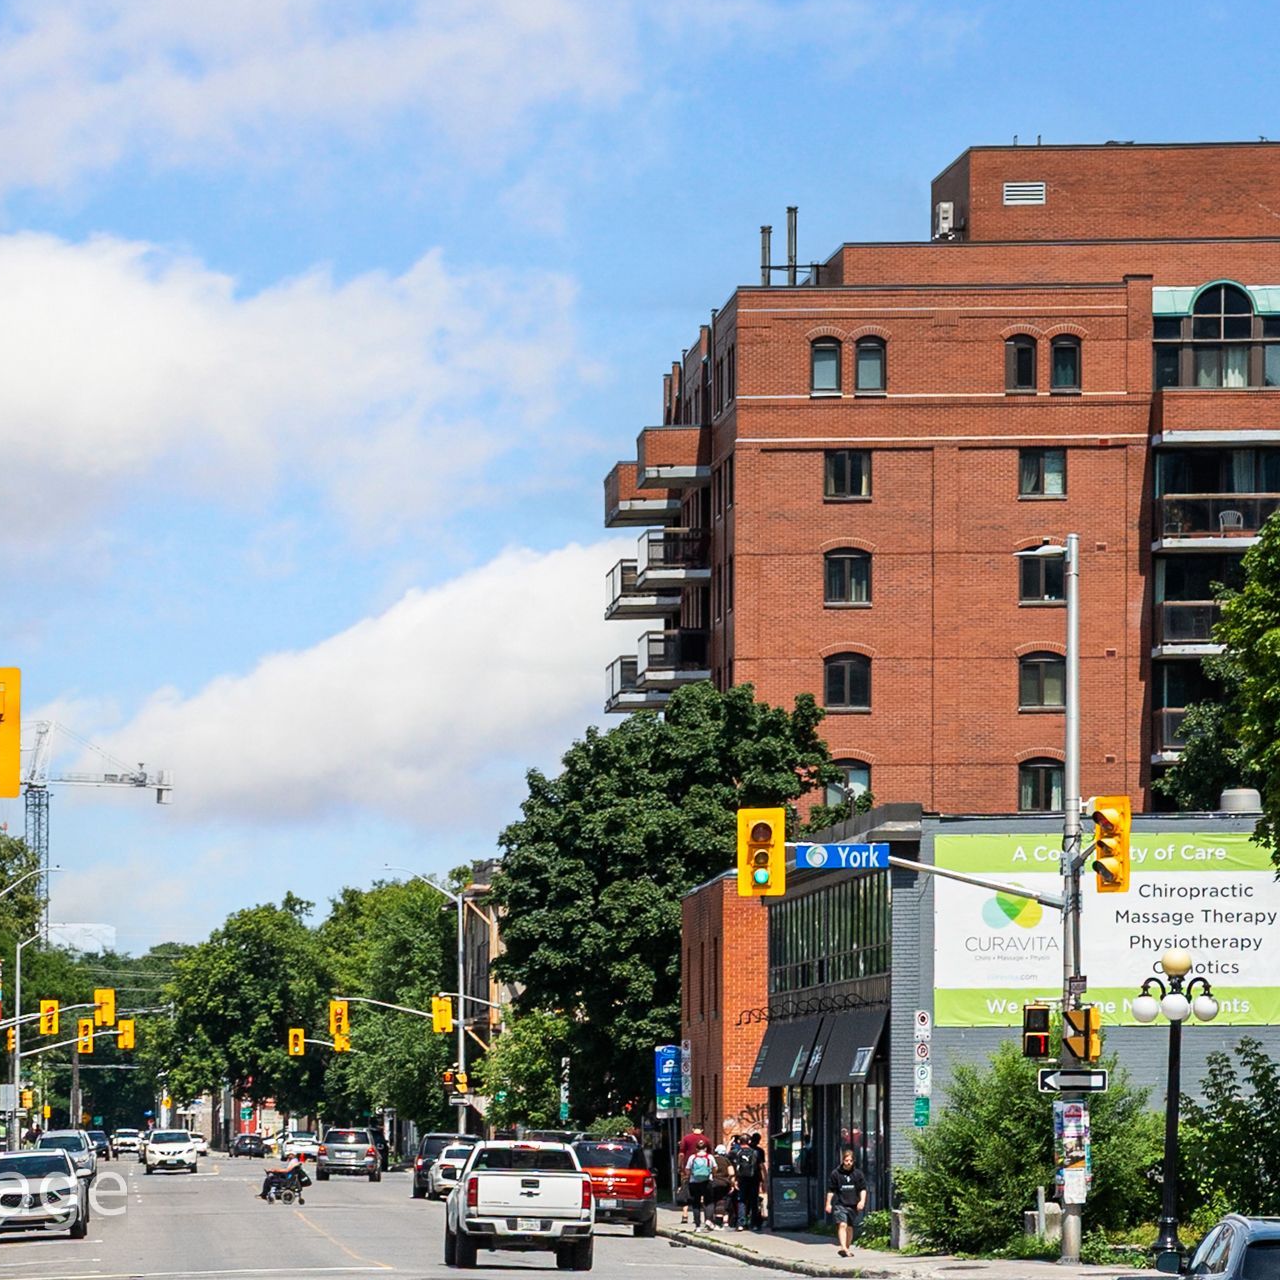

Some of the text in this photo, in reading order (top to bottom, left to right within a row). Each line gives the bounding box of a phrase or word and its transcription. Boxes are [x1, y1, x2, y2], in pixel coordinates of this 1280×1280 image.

[837, 845, 879, 867] York
[1012, 846, 1028, 861] A
[1154, 844, 1175, 860] of
[1181, 845, 1227, 860] Care
[1139, 883, 1254, 900] Chiropractic
[1115, 909, 1278, 926] Massage Therapy
[965, 936, 1060, 952] CURAVITA
[1130, 934, 1263, 951] Physiotherapy
[1153, 960, 1240, 974] Ootics
[986, 999, 1019, 1014] We
